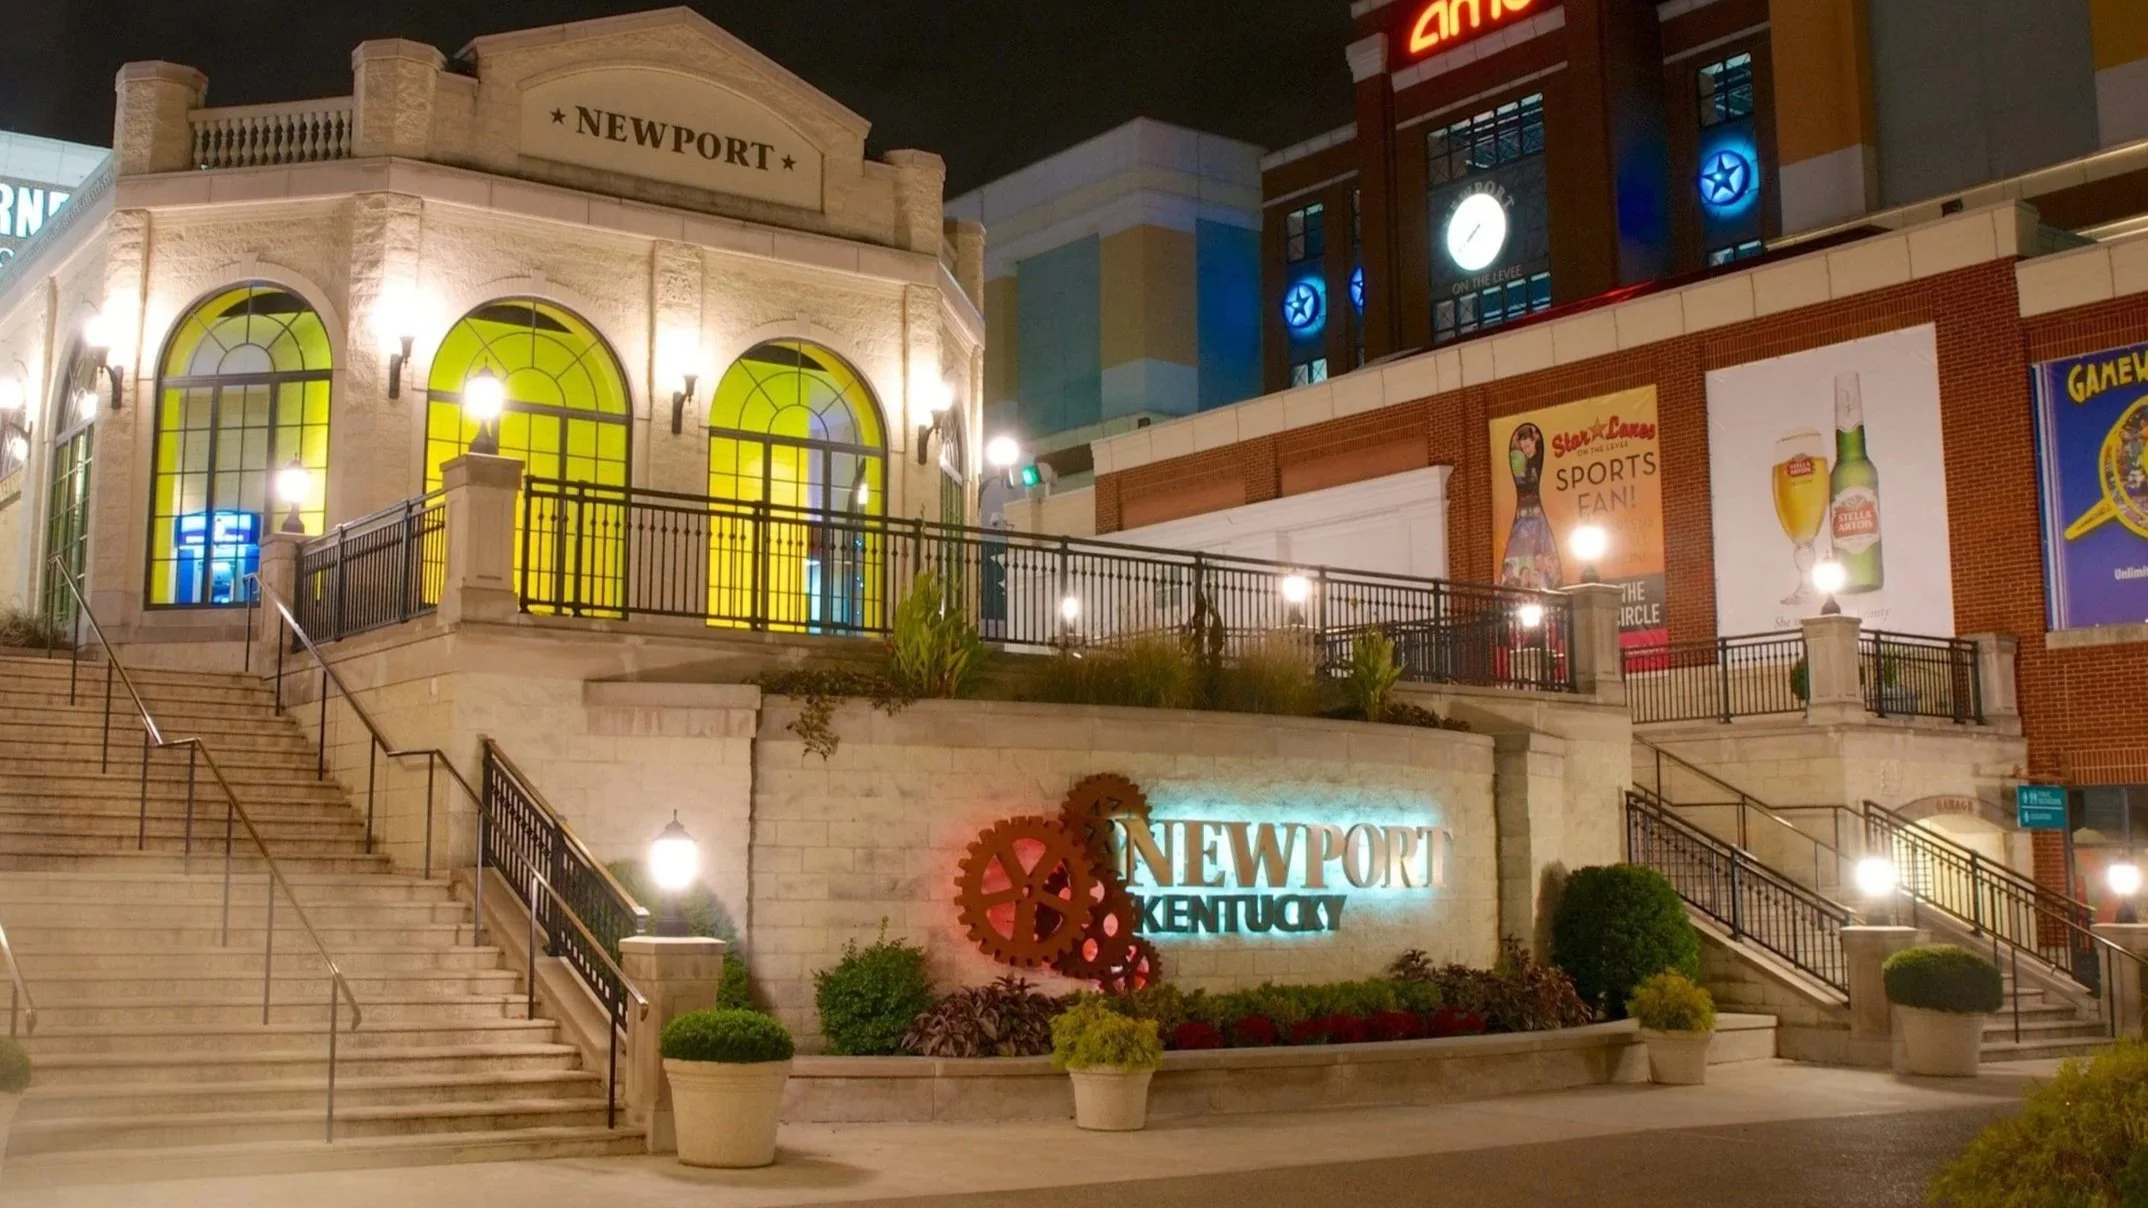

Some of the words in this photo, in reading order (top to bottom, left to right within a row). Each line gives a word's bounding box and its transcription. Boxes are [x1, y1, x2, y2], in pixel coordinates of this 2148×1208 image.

[1410, 0, 1532, 53] am
[574, 105, 775, 171] NEWPORT
[1452, 281, 1469, 295] ON
[1472, 274, 1490, 288] THE
[1492, 264, 1522, 283] LEVEE
[1551, 431, 1591, 458] Star
[1604, 415, 1655, 441] Lanes
[1556, 451, 1657, 492] SPORTS
[1578, 484, 1637, 517] FAN!
[1838, 508, 1873, 523] STELLA
[1621, 580, 1646, 603] THE
[1616, 603, 1661, 627] IRCLE
[1112, 818, 1453, 889] NEWPORT
[1134, 894, 1348, 934] KENTUCKY
